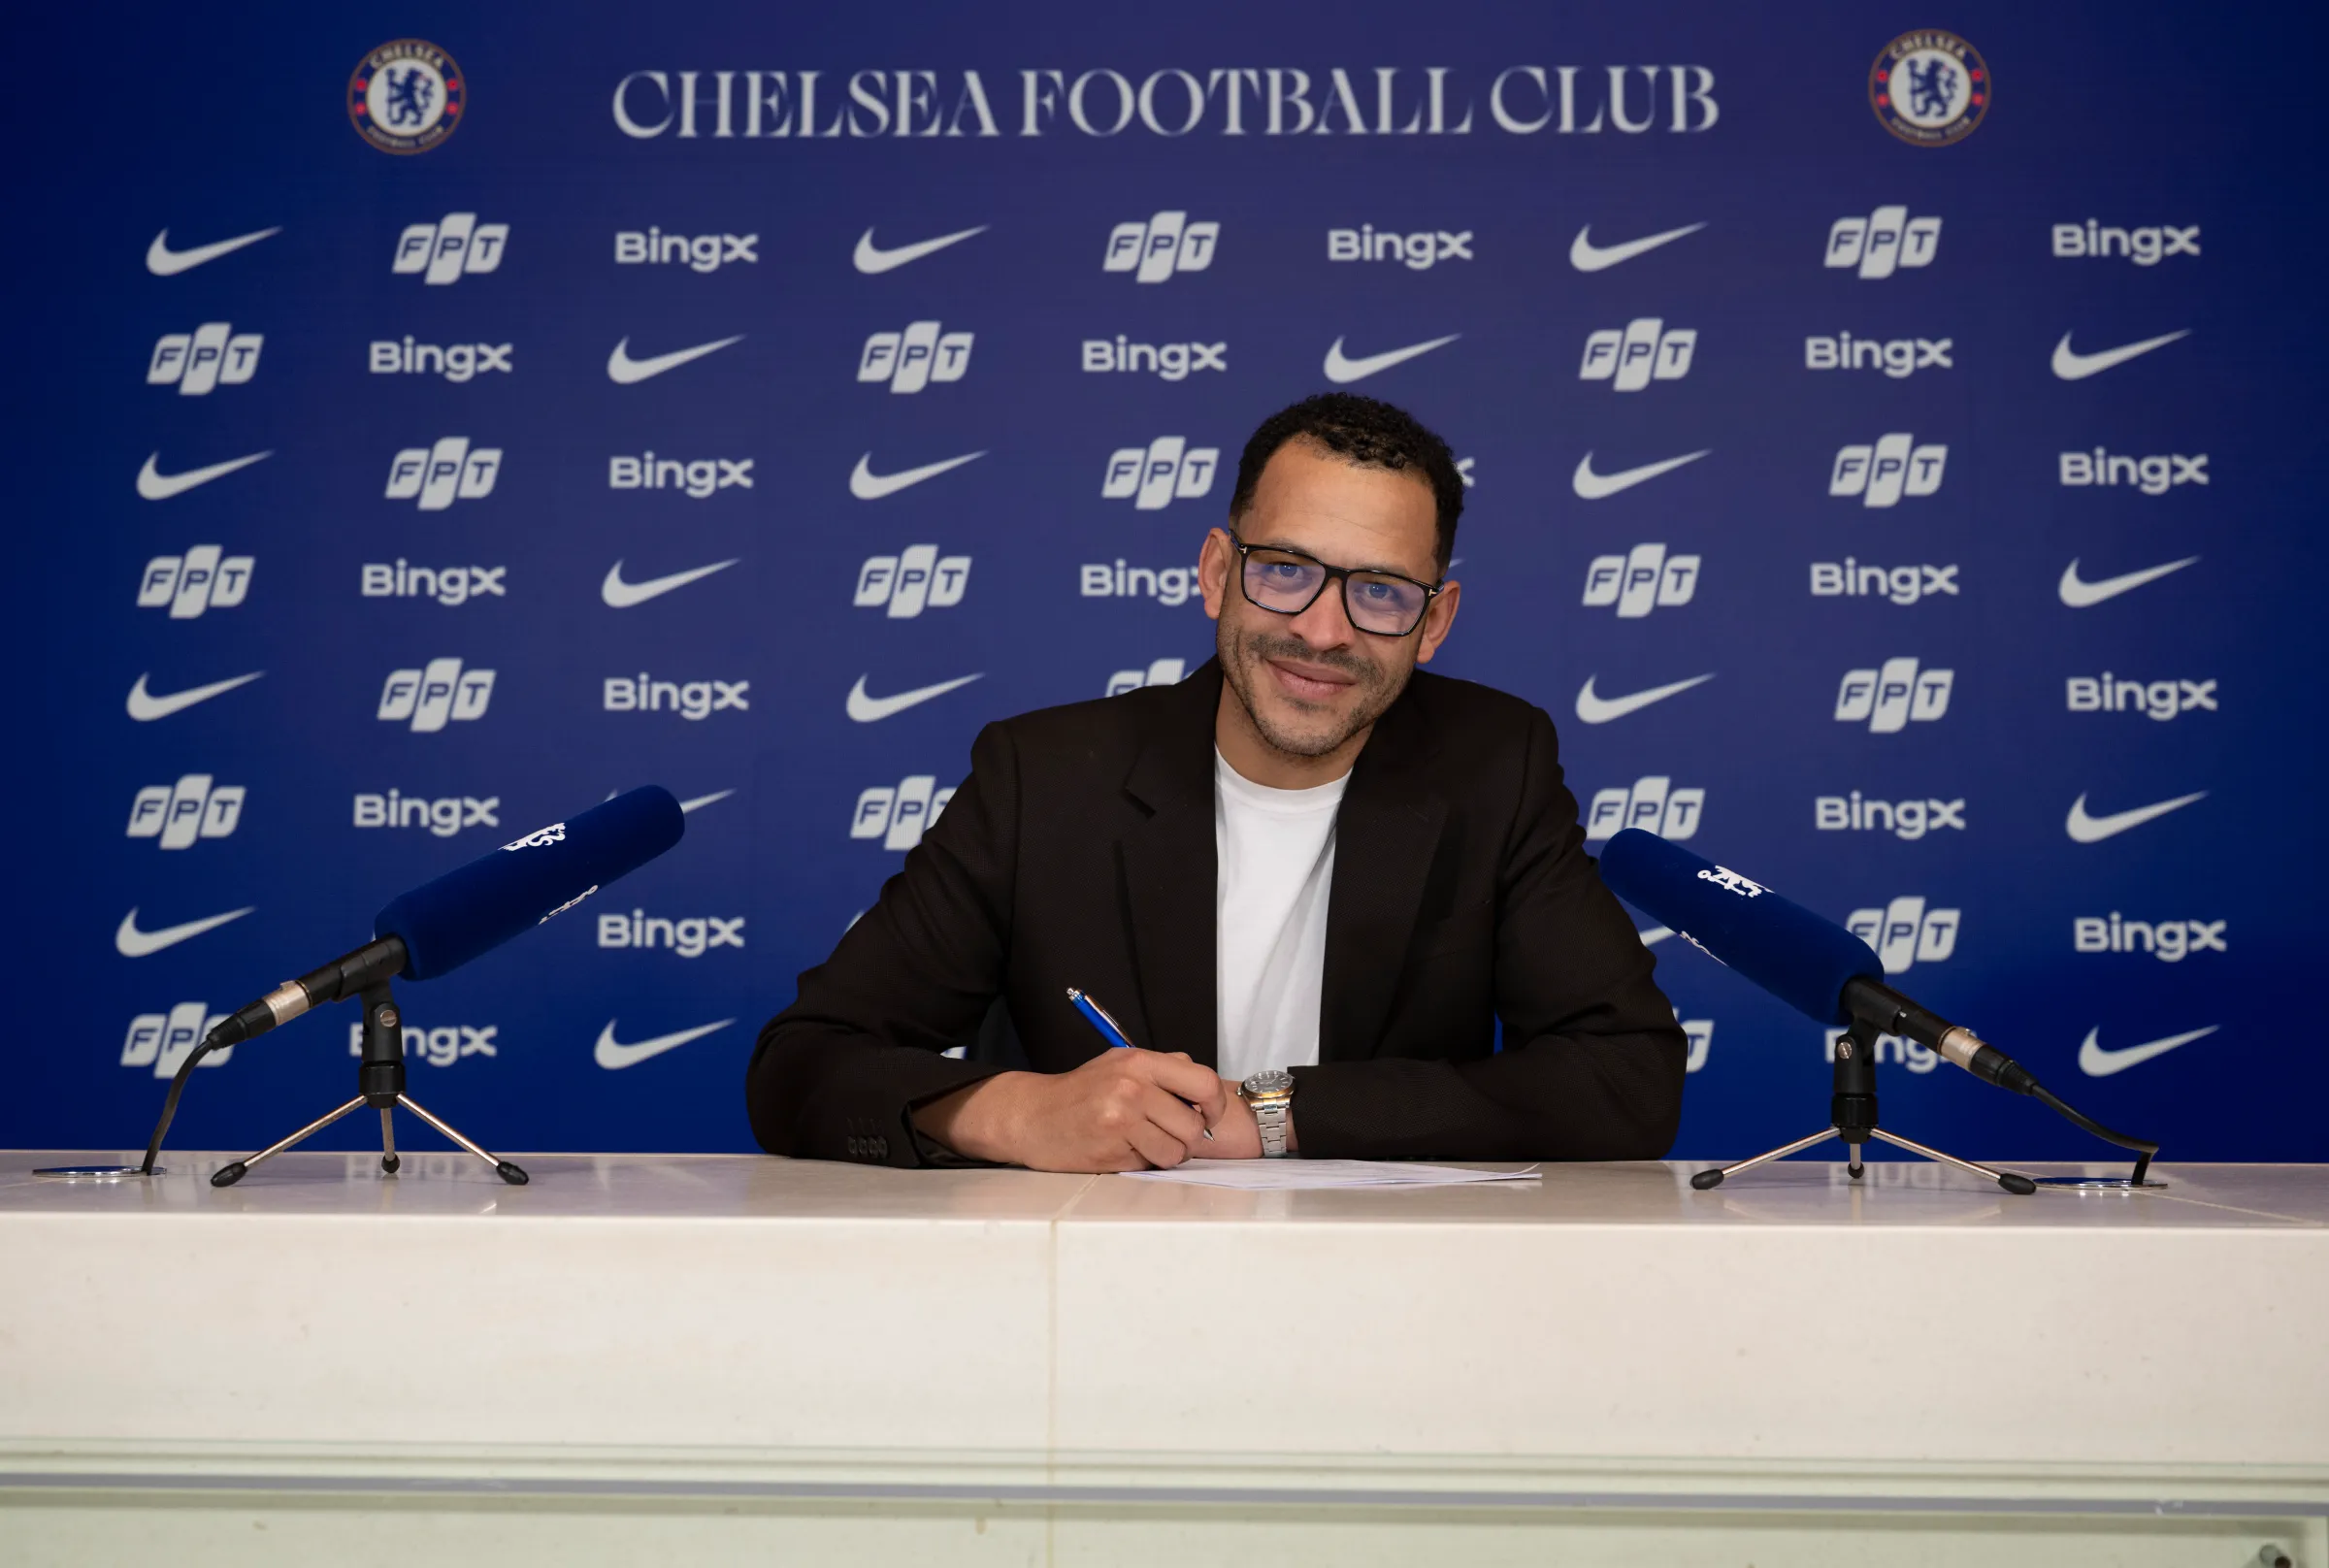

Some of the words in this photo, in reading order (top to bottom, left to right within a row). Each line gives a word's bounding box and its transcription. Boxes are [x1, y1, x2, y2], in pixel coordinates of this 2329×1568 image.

[612, 70, 1000, 139] CHELSEA
[1019, 68, 1473, 137] FOOTBALL
[1490, 65, 1720, 134] CLUB
